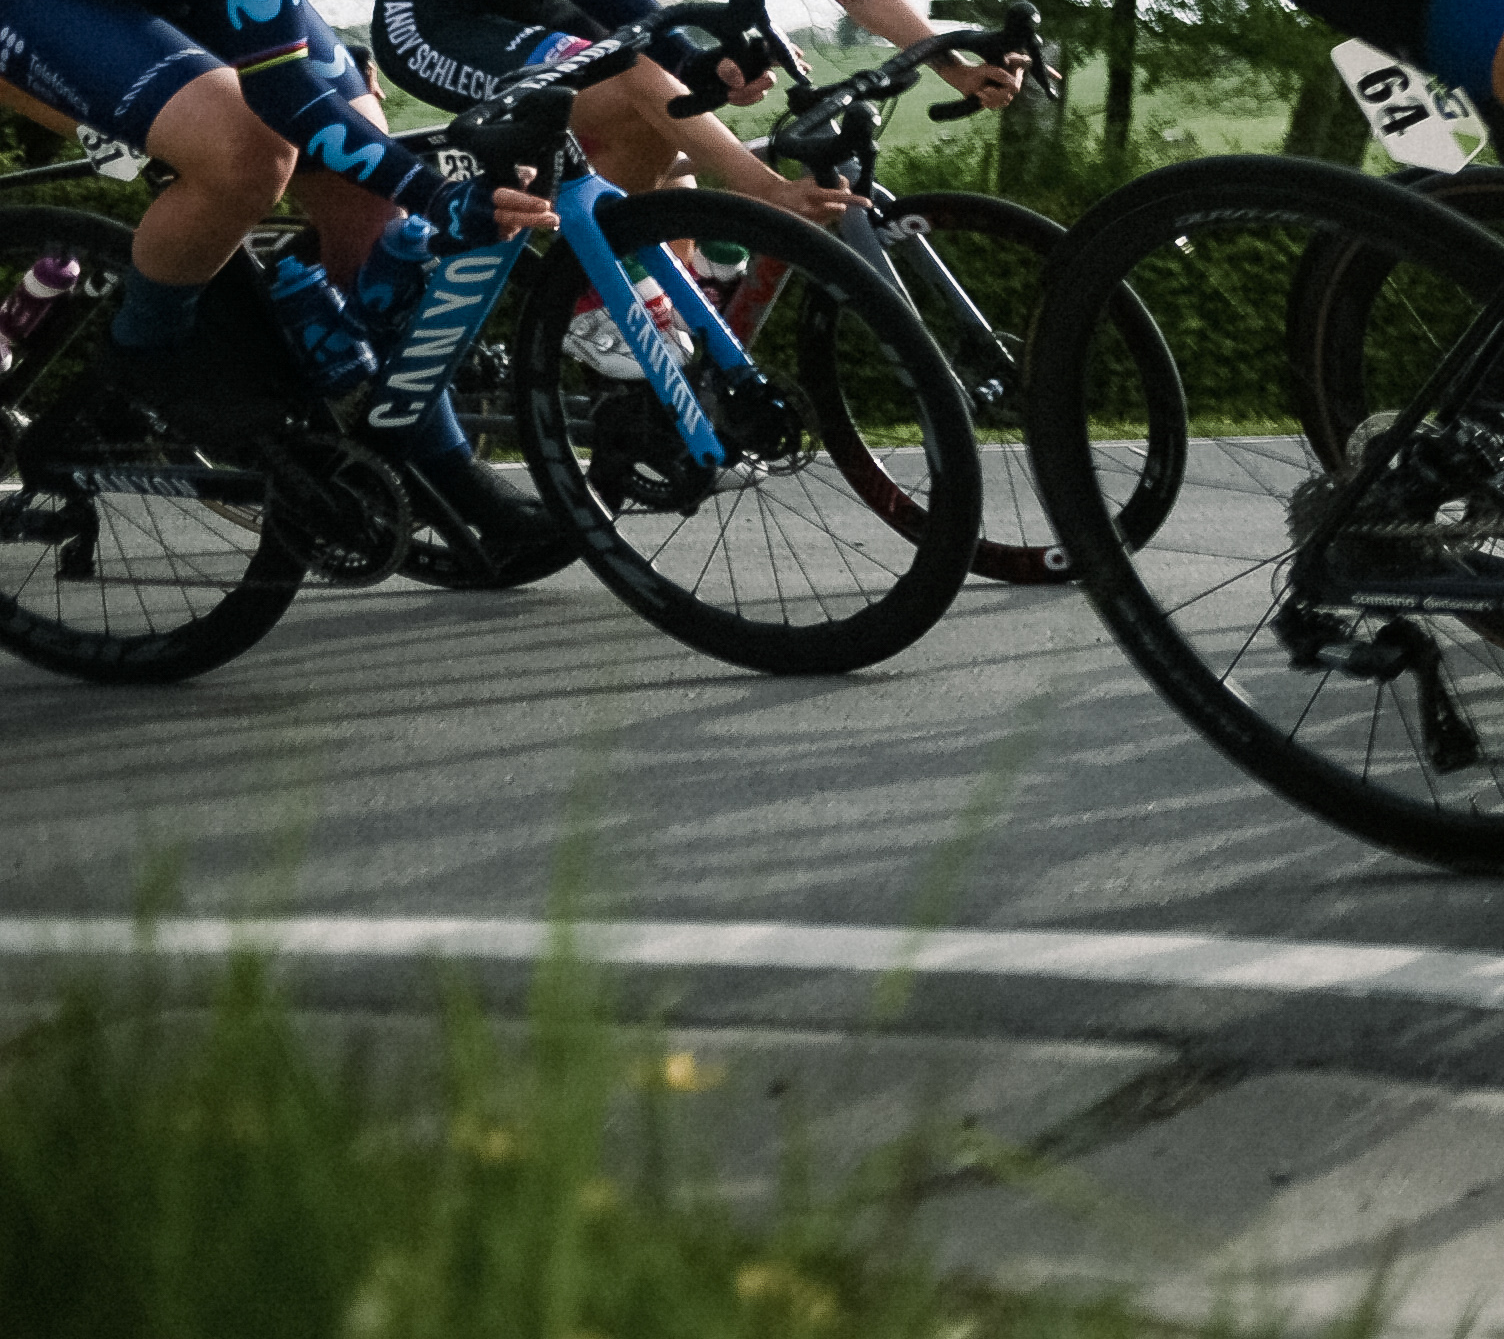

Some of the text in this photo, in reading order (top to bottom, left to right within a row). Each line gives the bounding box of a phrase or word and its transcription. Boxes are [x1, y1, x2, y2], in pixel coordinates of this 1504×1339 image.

[383, 0, 423, 56] ANDY
[1356, 64, 1431, 137] 64
[366, 253, 504, 428] CANYO
